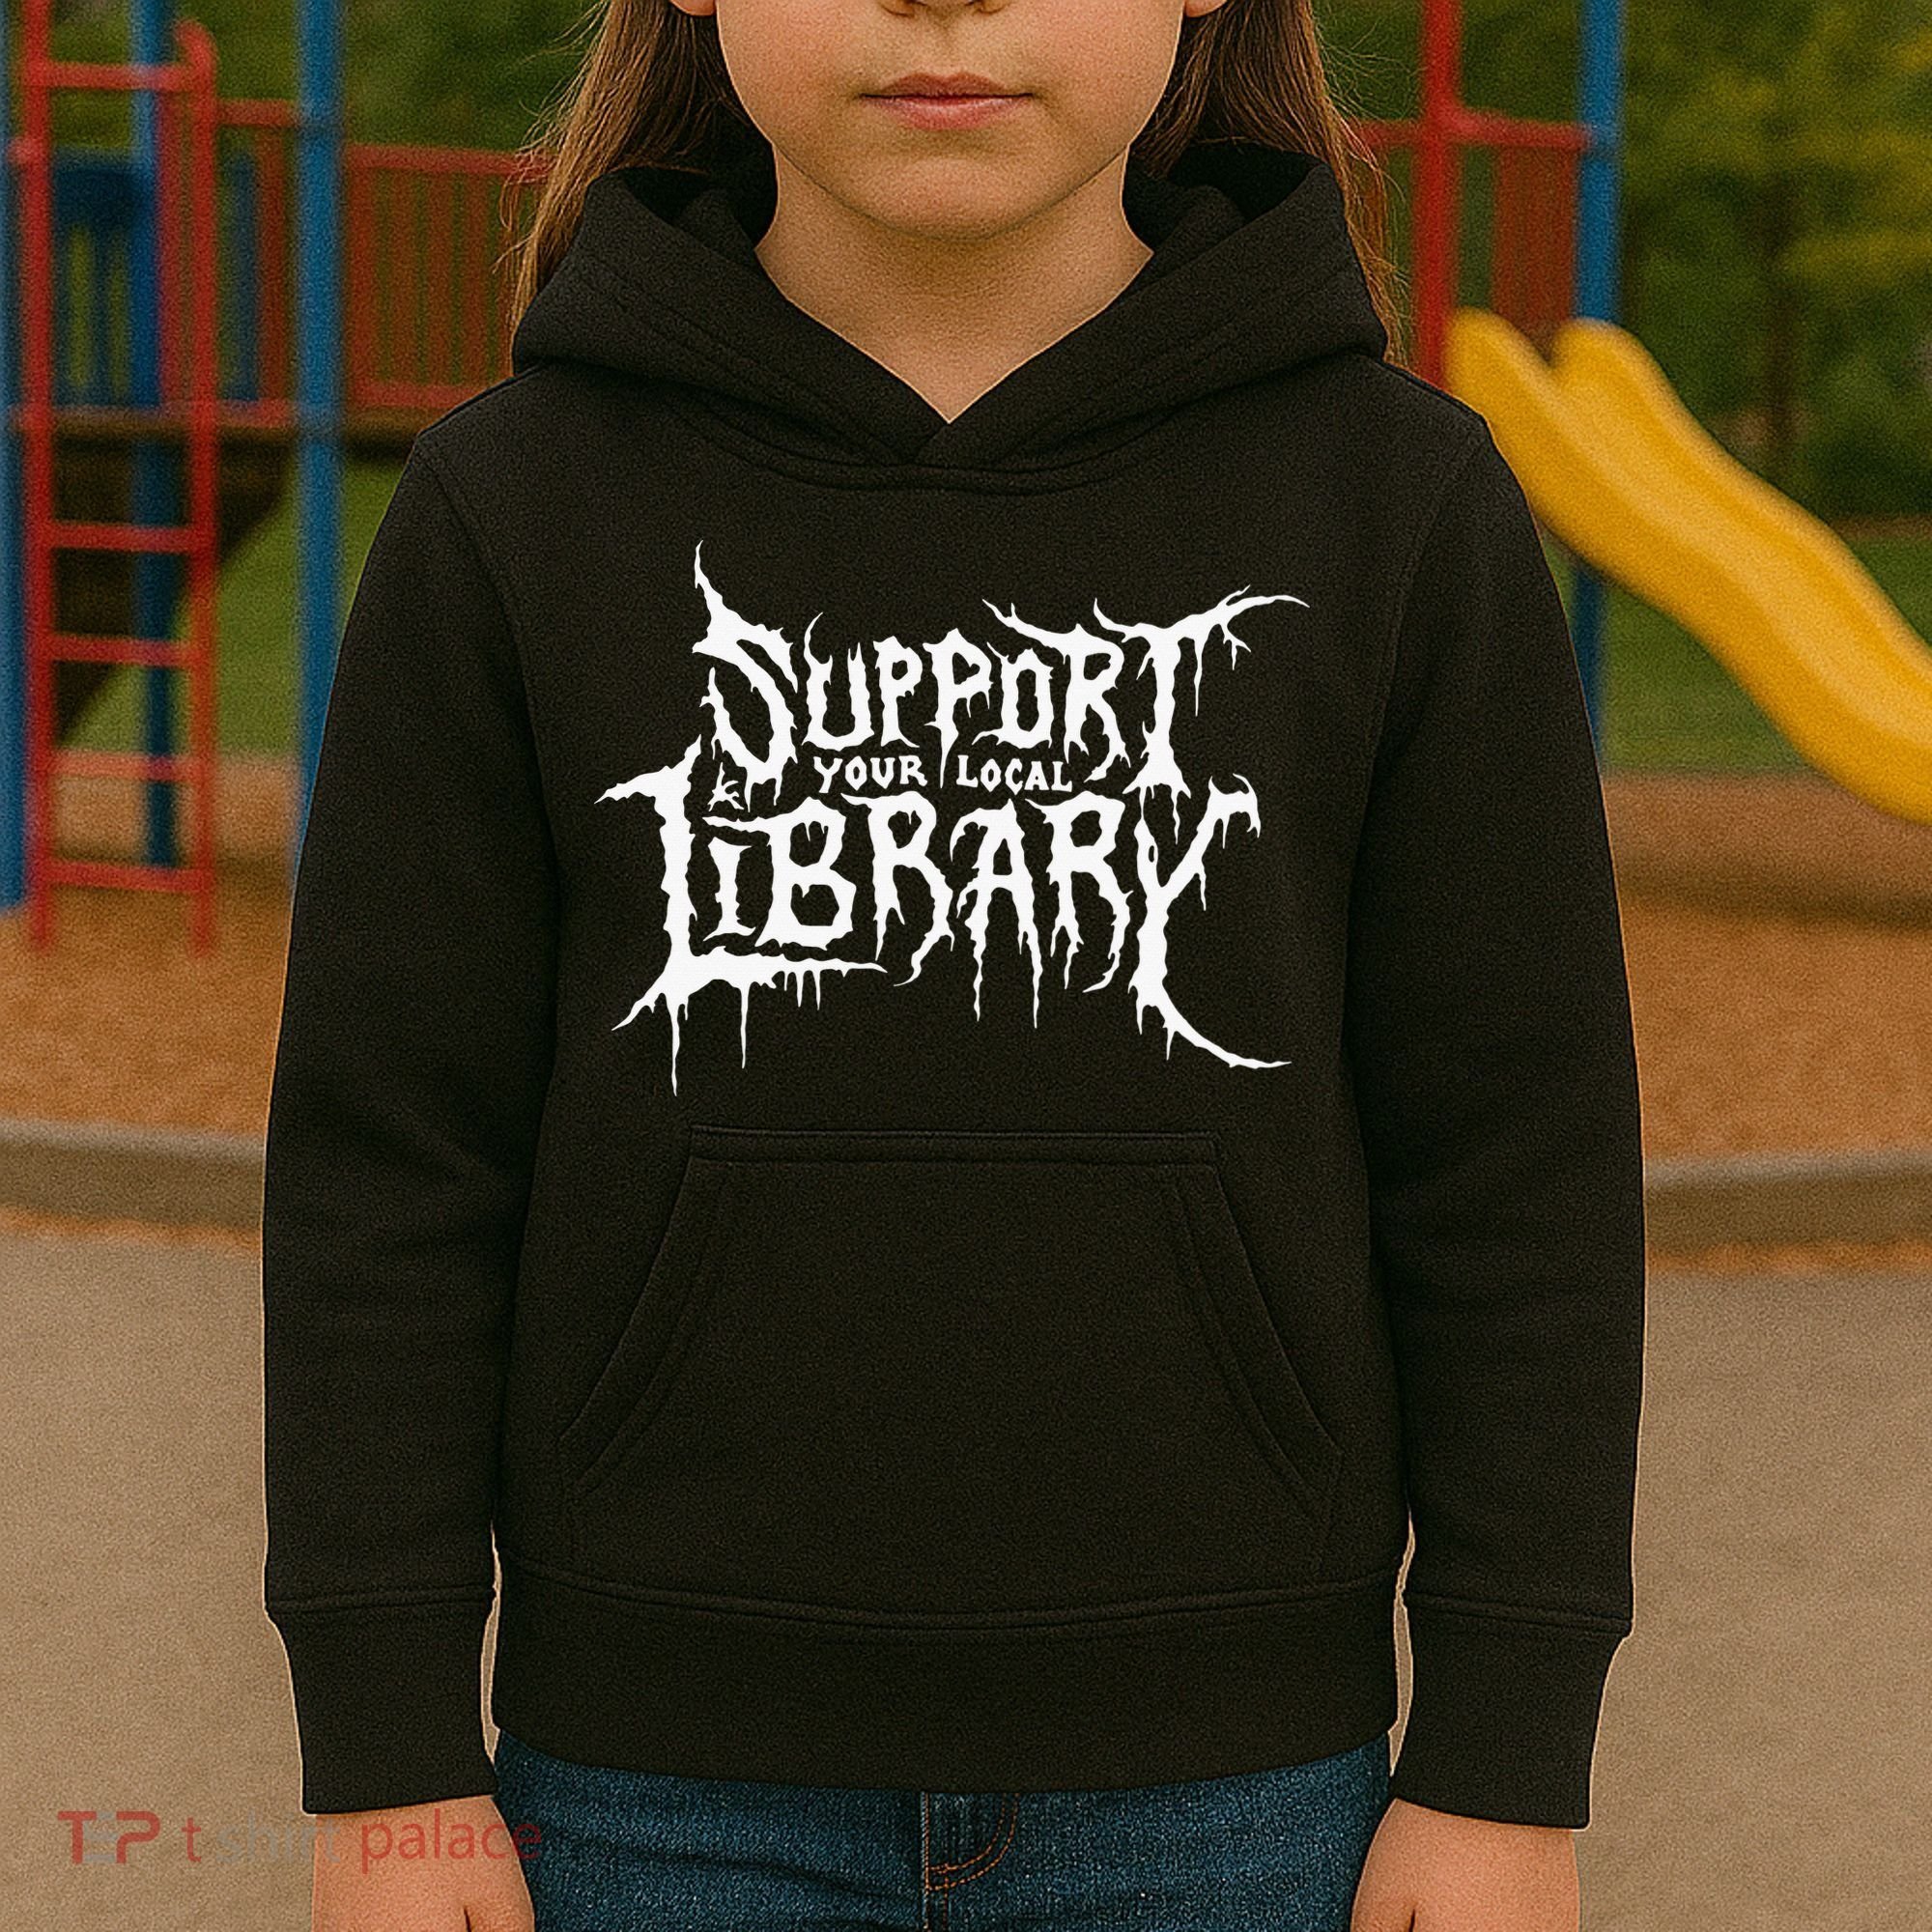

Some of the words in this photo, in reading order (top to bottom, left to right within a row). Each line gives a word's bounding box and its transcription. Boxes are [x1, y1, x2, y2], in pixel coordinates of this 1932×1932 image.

[693, 540, 1309, 843] SUPPORT
[813, 755, 927, 793] YOUR
[956, 755, 1072, 795] LOCAL
